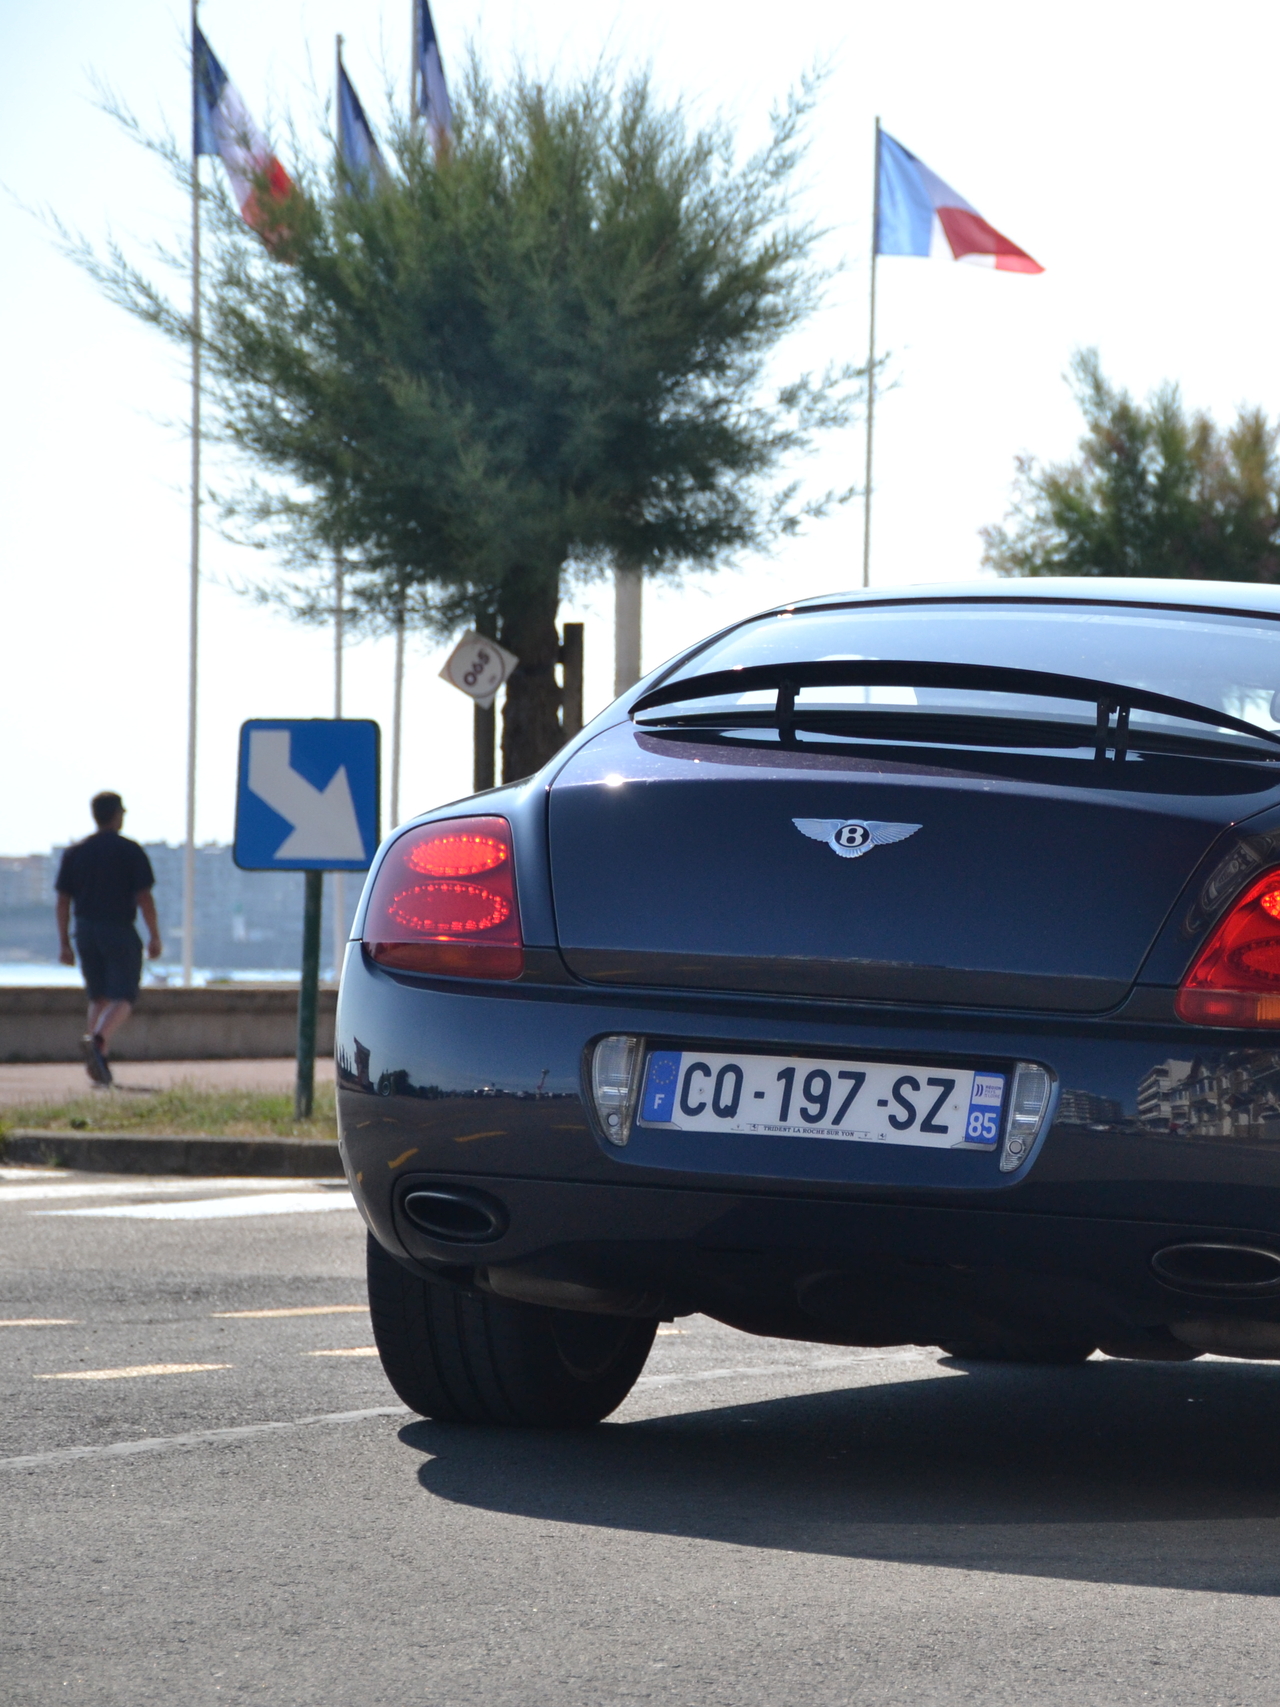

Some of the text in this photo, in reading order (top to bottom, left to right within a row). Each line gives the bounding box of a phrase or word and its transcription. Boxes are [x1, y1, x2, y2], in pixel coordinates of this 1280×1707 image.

[840, 825, 864, 847] B
[654, 1094, 665, 1109] F
[968, 1111, 997, 1138] 85
